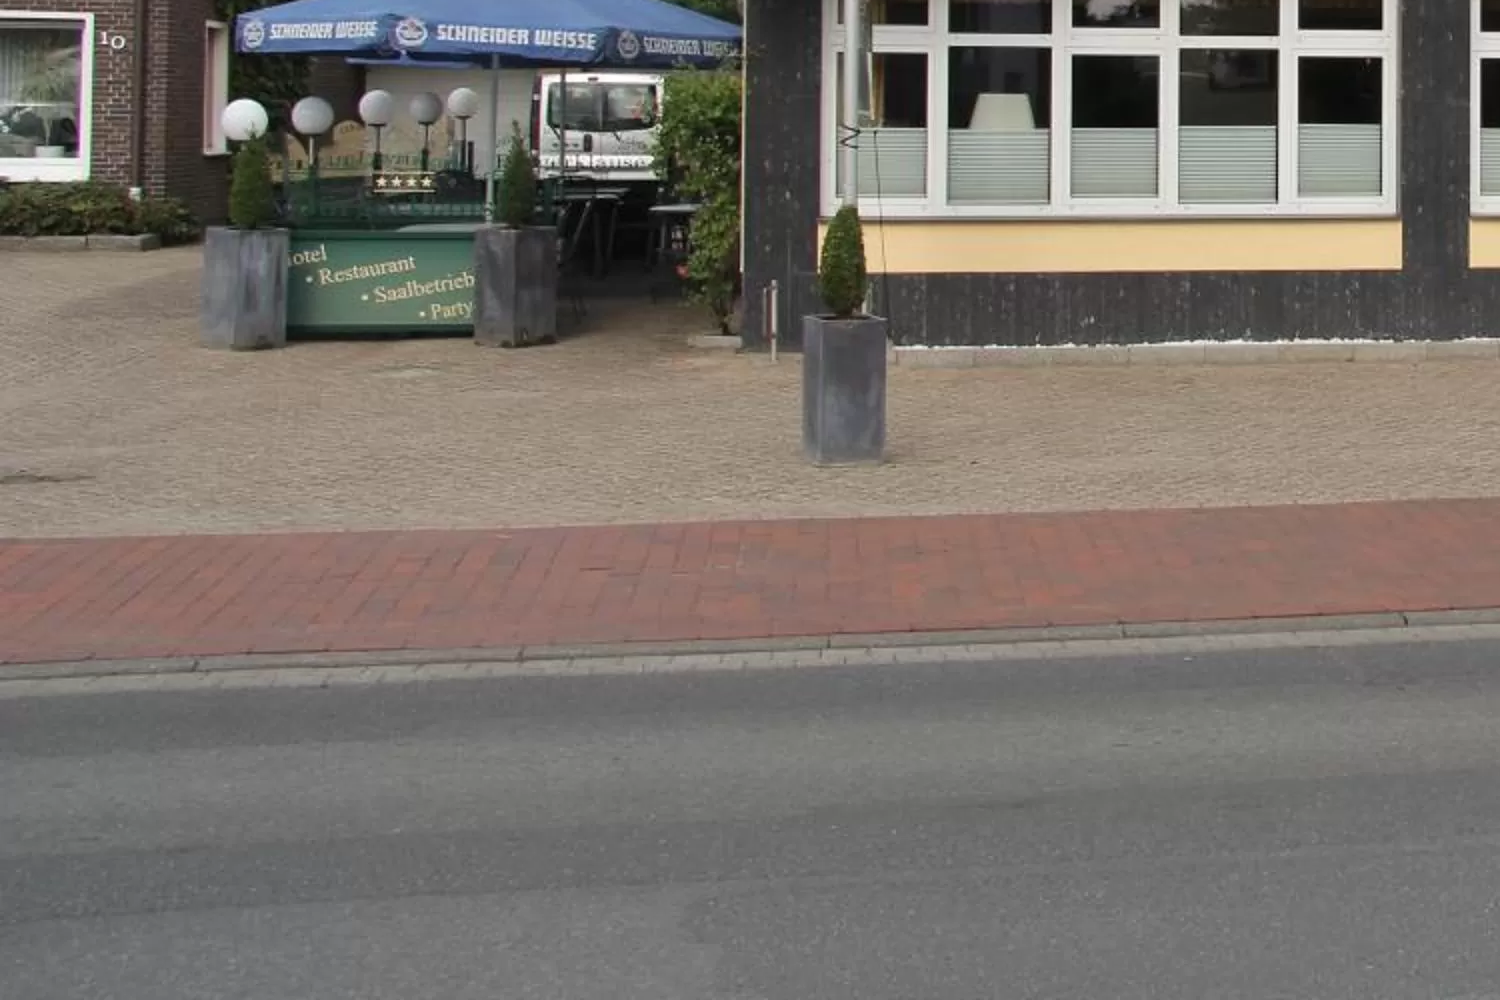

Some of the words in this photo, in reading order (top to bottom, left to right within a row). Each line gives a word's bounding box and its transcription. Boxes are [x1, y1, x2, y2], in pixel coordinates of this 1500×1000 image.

[99, 31, 126, 49] 10
[436, 24, 529, 45] SCHNEIDER
[534, 28, 598, 51] WEISSE
[317, 256, 417, 286] Restaurant
[373, 271, 475, 304] Saalbetrieb
[430, 301, 473, 321] Party
